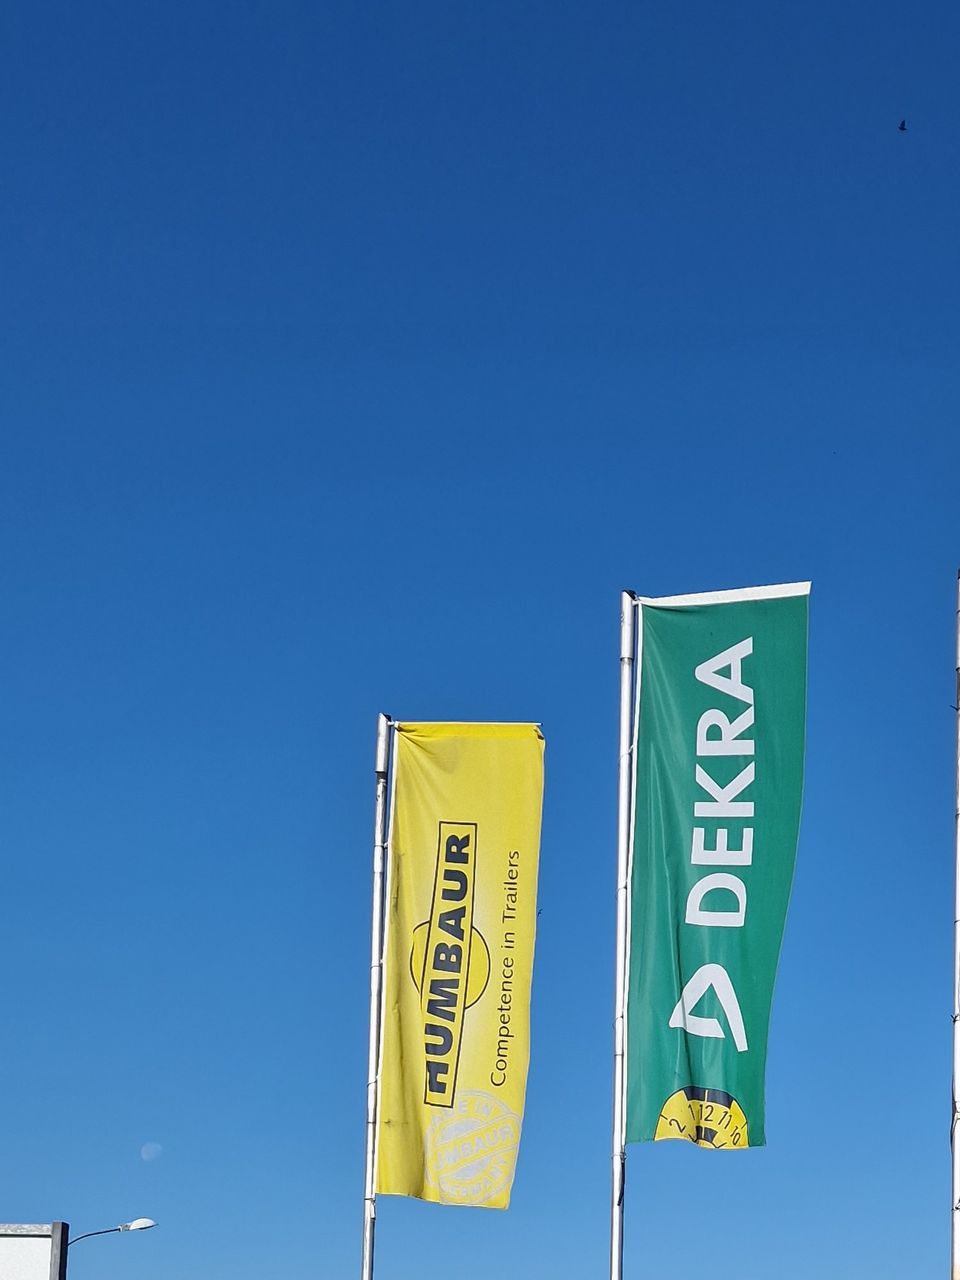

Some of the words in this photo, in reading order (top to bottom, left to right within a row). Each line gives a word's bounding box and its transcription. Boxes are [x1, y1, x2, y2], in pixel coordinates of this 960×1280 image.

[686, 636, 755, 928] DEKRA
[502, 851, 519, 924] Trailers
[425, 833, 470, 1094] HUMBAUR
[501, 931, 515, 949] in
[491, 957, 514, 1087] Competence
[698, 1103, 714, 1122] 12
[718, 1110, 732, 1130] 11
